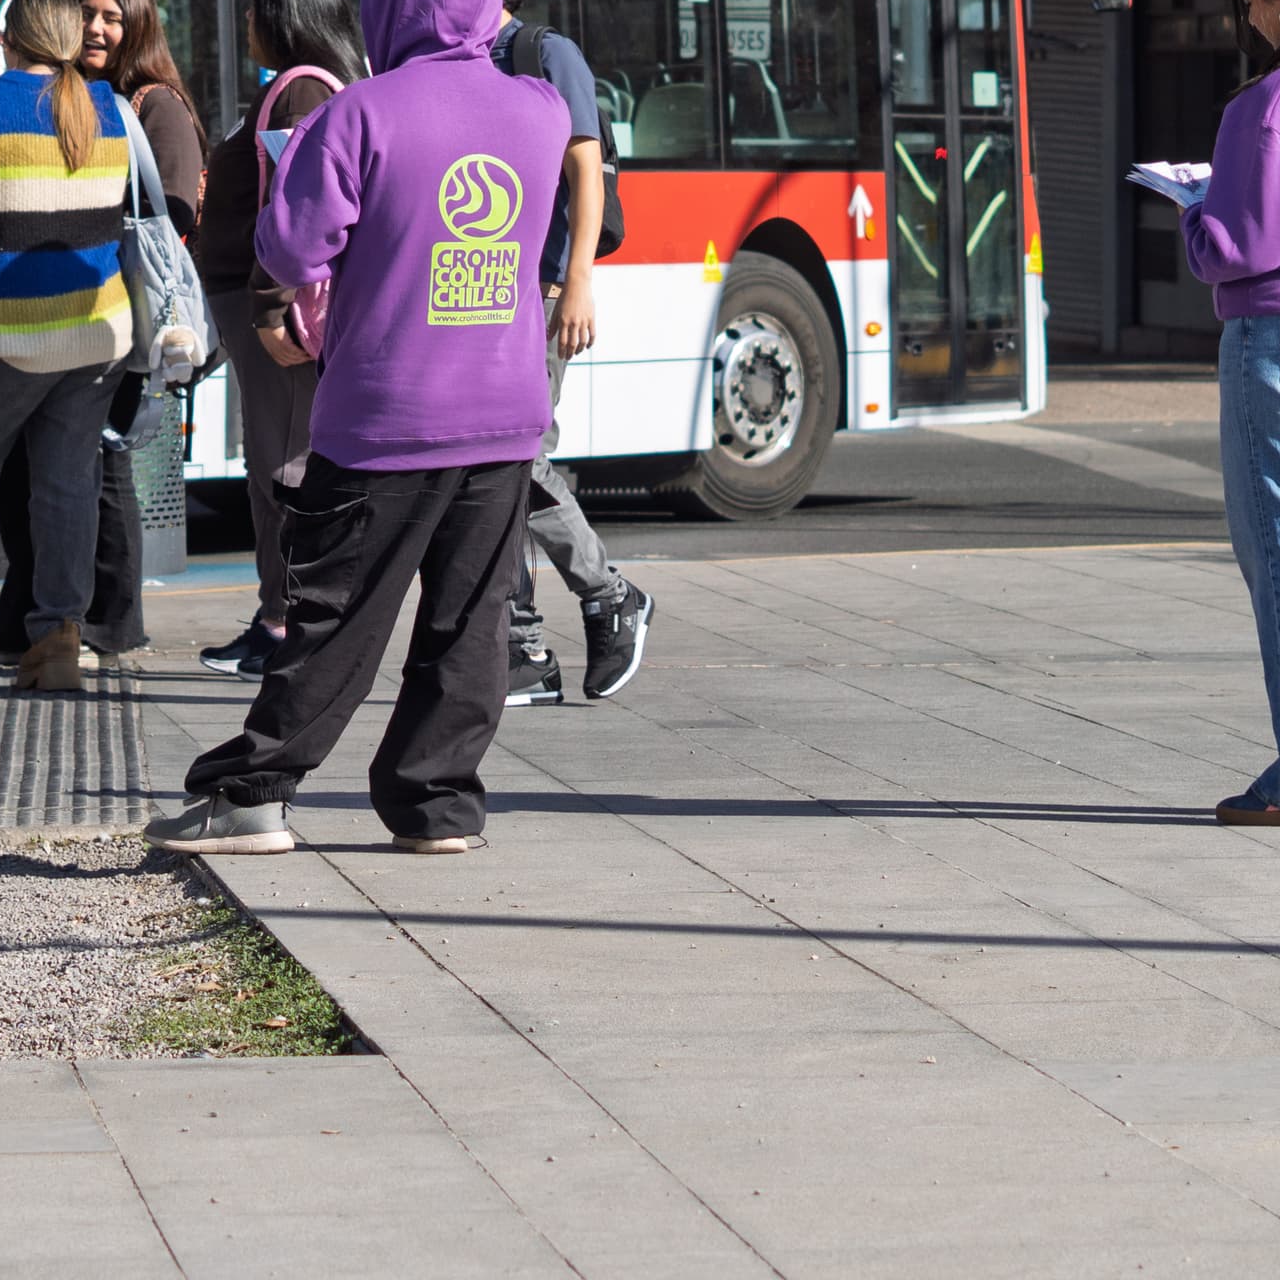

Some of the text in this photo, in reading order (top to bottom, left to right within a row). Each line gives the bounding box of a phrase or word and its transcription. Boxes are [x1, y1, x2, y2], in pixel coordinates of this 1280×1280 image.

[437, 249, 516, 269] CROHN
[435, 267, 514, 288] COLITIS
[433, 287, 494, 308] CHILE
